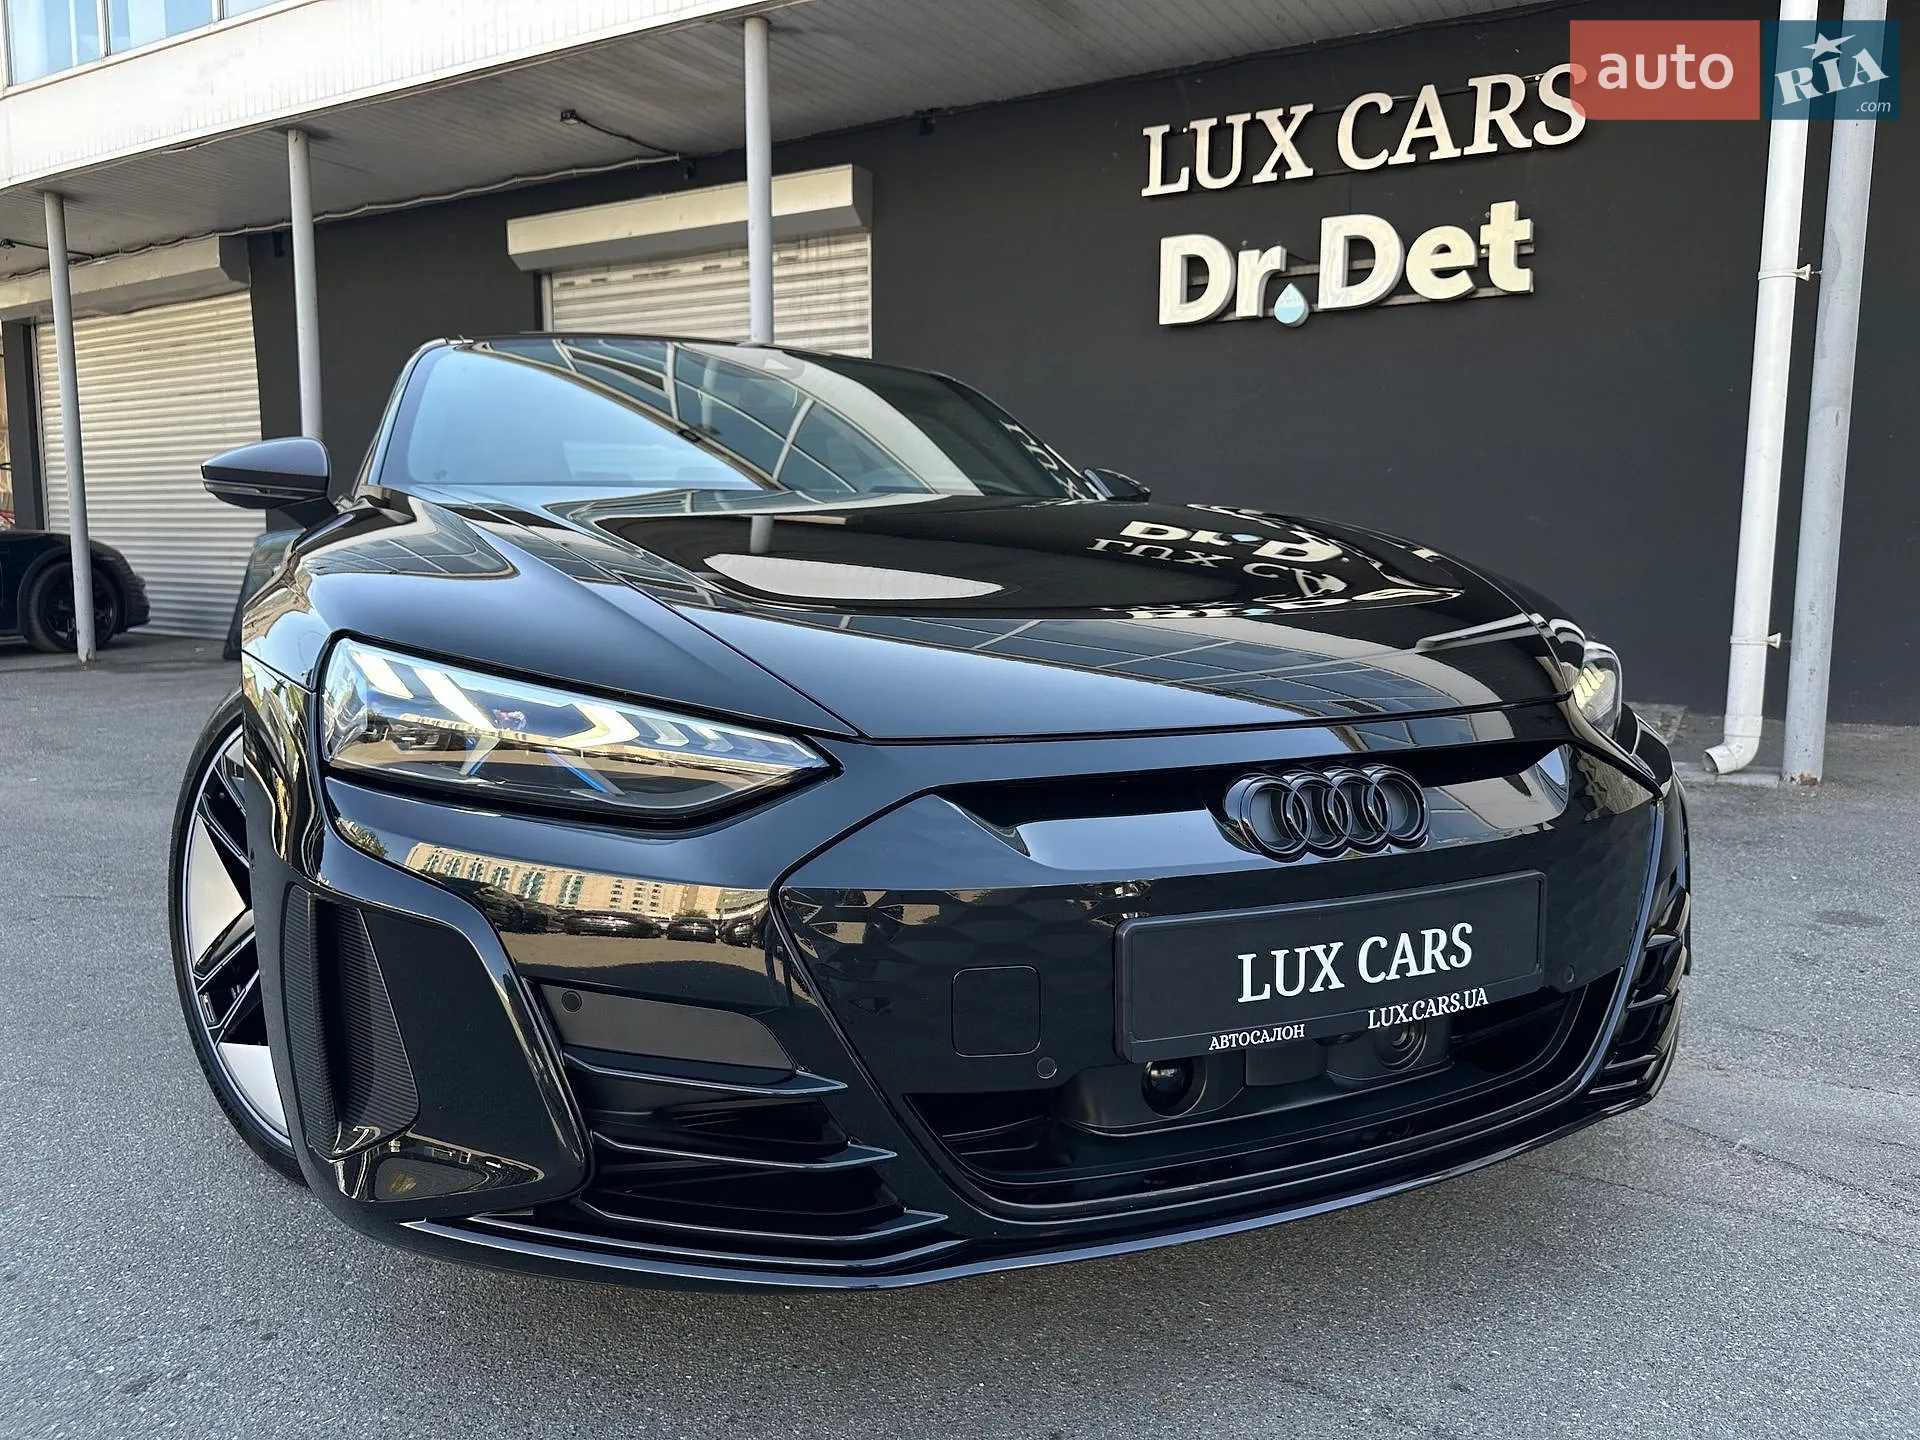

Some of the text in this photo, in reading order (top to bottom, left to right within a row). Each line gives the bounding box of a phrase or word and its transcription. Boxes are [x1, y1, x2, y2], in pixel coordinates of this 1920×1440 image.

[1140, 62, 1589, 198] LUX CARS
[1237, 922, 1473, 1003] LUX CARS
[1208, 1023, 1305, 1051] АВТОСАЛОН
[1367, 987, 1489, 1030] LUX.CARS.UA
